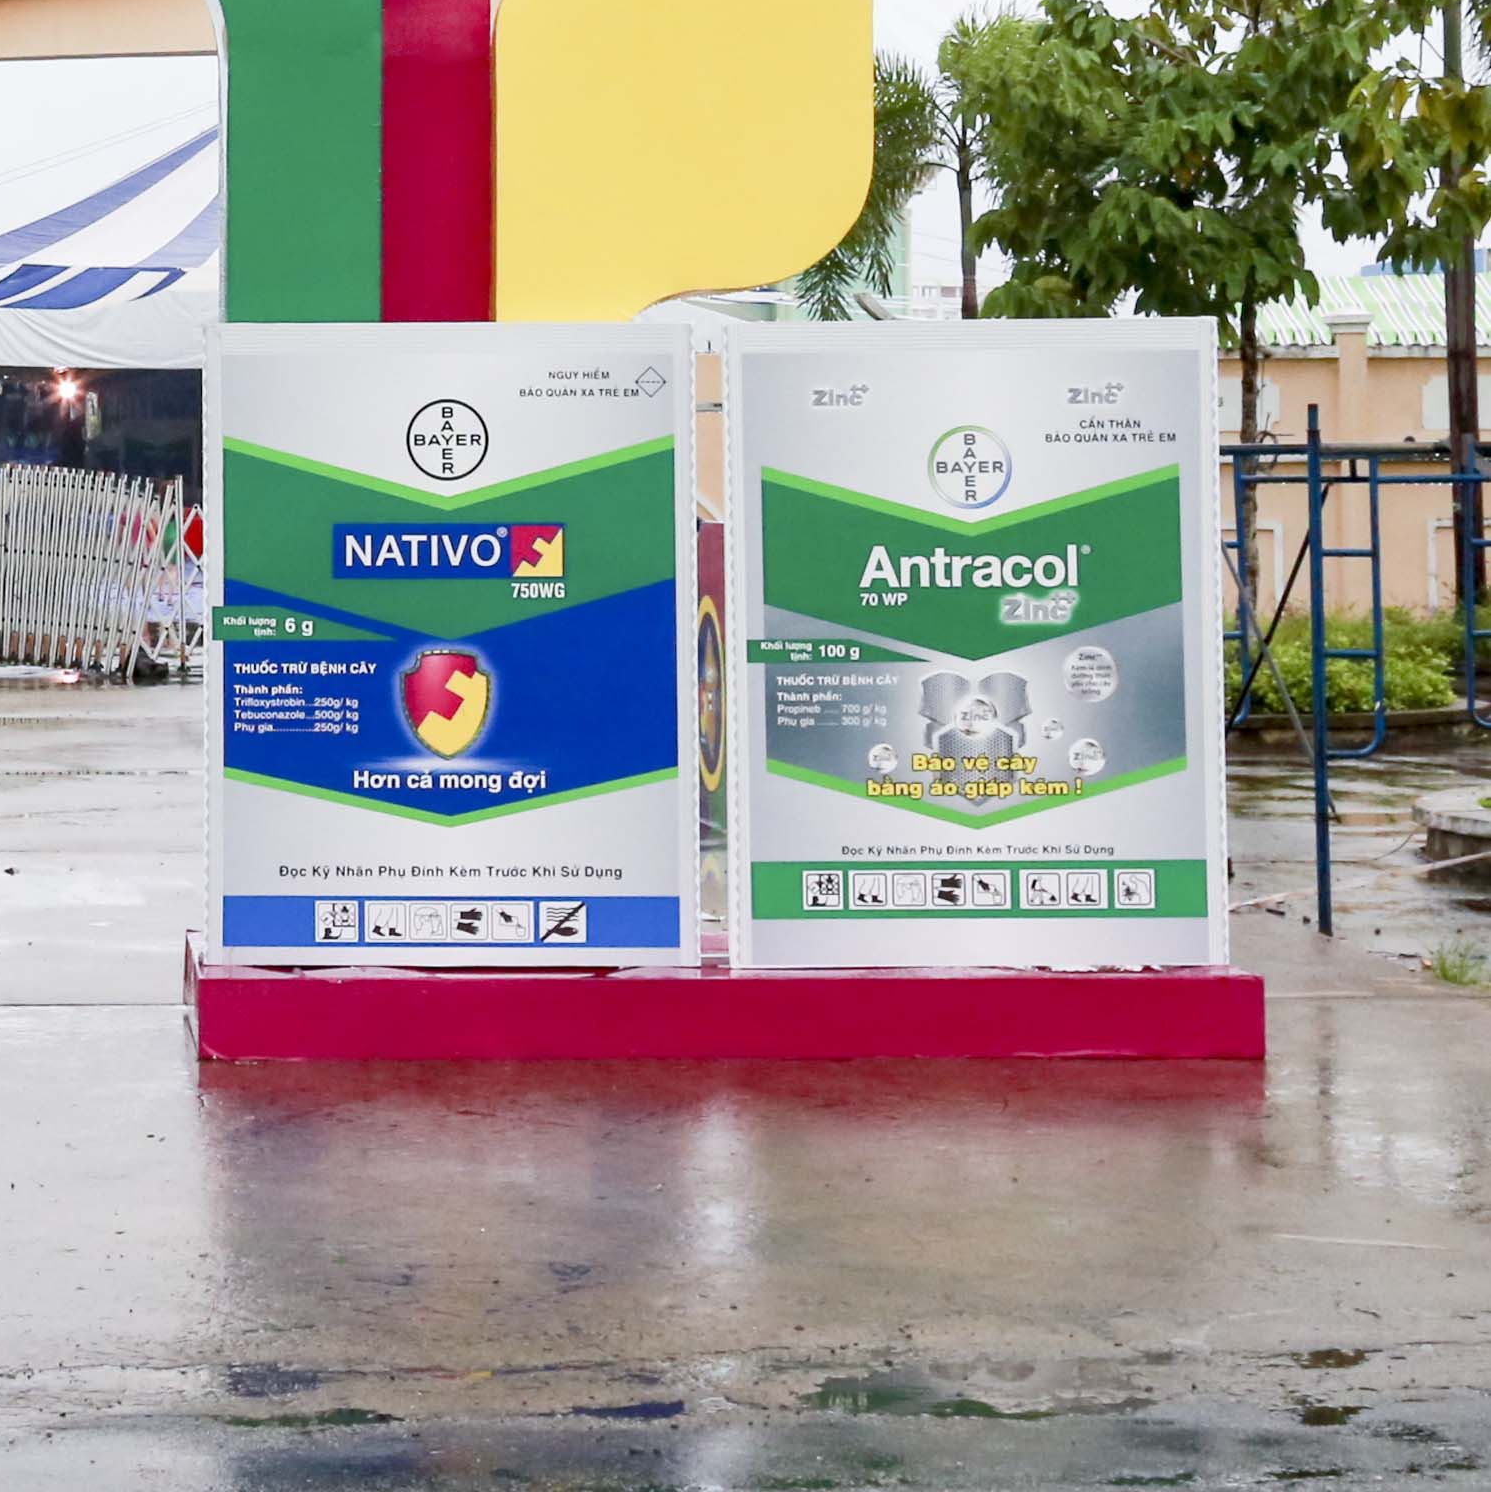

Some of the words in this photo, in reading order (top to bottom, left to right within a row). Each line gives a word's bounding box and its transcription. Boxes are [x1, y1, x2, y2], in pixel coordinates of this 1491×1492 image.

[548, 371, 579, 380] NGUY
[581, 388, 595, 397] XA
[623, 388, 640, 397] EM
[413, 434, 482, 446] BAYER
[441, 406, 455, 475] BAYER
[1112, 433, 1128, 443] XA
[1159, 433, 1177, 443] EM
[935, 461, 1004, 474] BAYER
[963, 432, 978, 502] BAYER
[511, 582, 565, 599] 750WG
[859, 593, 878, 606] 70
[882, 593, 908, 606] WP
[223, 616, 246, 626] Khối
[248, 616, 277, 628] lượng
[284, 617, 297, 634] 6
[301, 619, 314, 637] g
[818, 645, 846, 658] 100
[850, 646, 861, 661] g
[233, 658, 278, 675] THUỐC
[281, 660, 308, 675] TRỪ
[310, 660, 347, 676] BỆNH
[350, 660, 378, 675] CÂY
[777, 672, 815, 686] THUỐC
[842, 674, 874, 687] BỆNH
[876, 673, 900, 686] CÂY
[234, 684, 269, 695] Thành
[777, 691, 810, 701] Thành
[346, 697, 359, 708] kg
[346, 710, 359, 721] kg
[777, 717, 798, 727] Phụ
[234, 723, 255, 733] Phụ
[346, 723, 359, 734] kg
[912, 753, 956, 771] Bảo
[996, 753, 1038, 774] cây
[353, 770, 401, 789] Hơn
[406, 770, 433, 789] cả
[439, 773, 502, 793] mong
[508, 770, 546, 793] đợi
[866, 775, 923, 798] bằng
[929, 778, 958, 796] áo
[964, 778, 1013, 799] giáp
[1019, 778, 1069, 796] kẽm
[1074, 778, 1083, 795] !
[841, 845, 864, 856] Đọc
[920, 845, 943, 856] Phụ
[1042, 845, 1061, 855] Khi
[1084, 845, 1114, 856] Dụng
[279, 865, 307, 878] Đọc
[312, 864, 330, 879] Kỹ
[336, 865, 373, 877] Nhãn
[378, 866, 406, 879] Phụ
[449, 865, 481, 877] Kèm
[486, 865, 527, 877] Trước
[532, 865, 556, 877] Khi
[584, 866, 623, 880] Dụng
